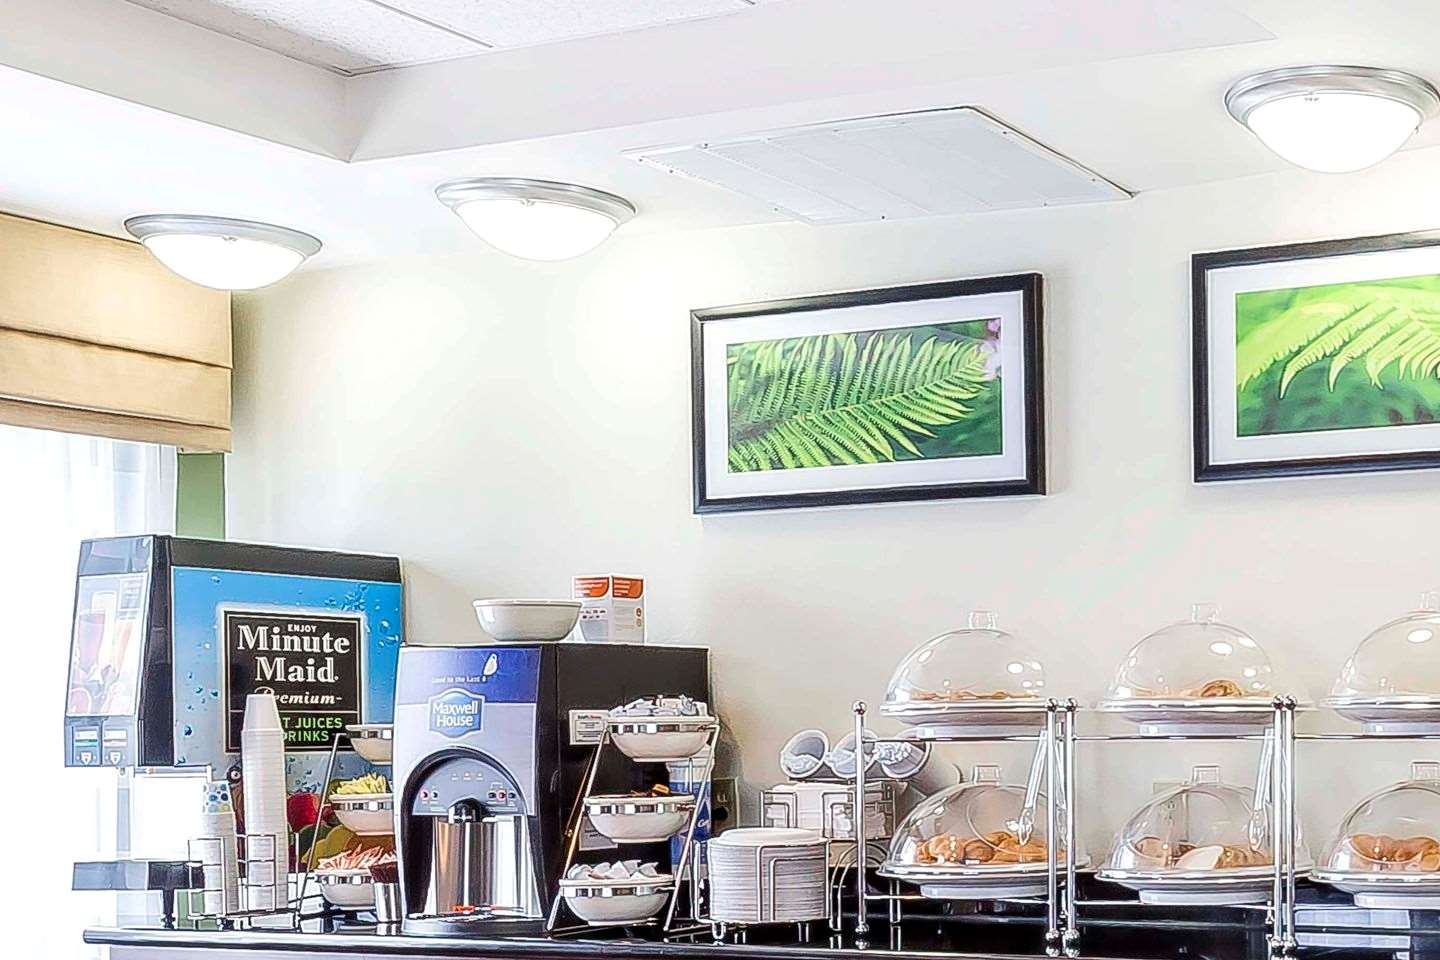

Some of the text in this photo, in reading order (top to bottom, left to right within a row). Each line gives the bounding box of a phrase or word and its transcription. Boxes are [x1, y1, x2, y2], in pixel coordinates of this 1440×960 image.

[287, 624, 317, 633] ENJOY
[237, 624, 350, 654] Minute
[255, 656, 336, 683] Maid
[432, 700, 478, 715] Maxwell
[294, 717, 343, 729] JUICES
[436, 715, 474, 727] House
